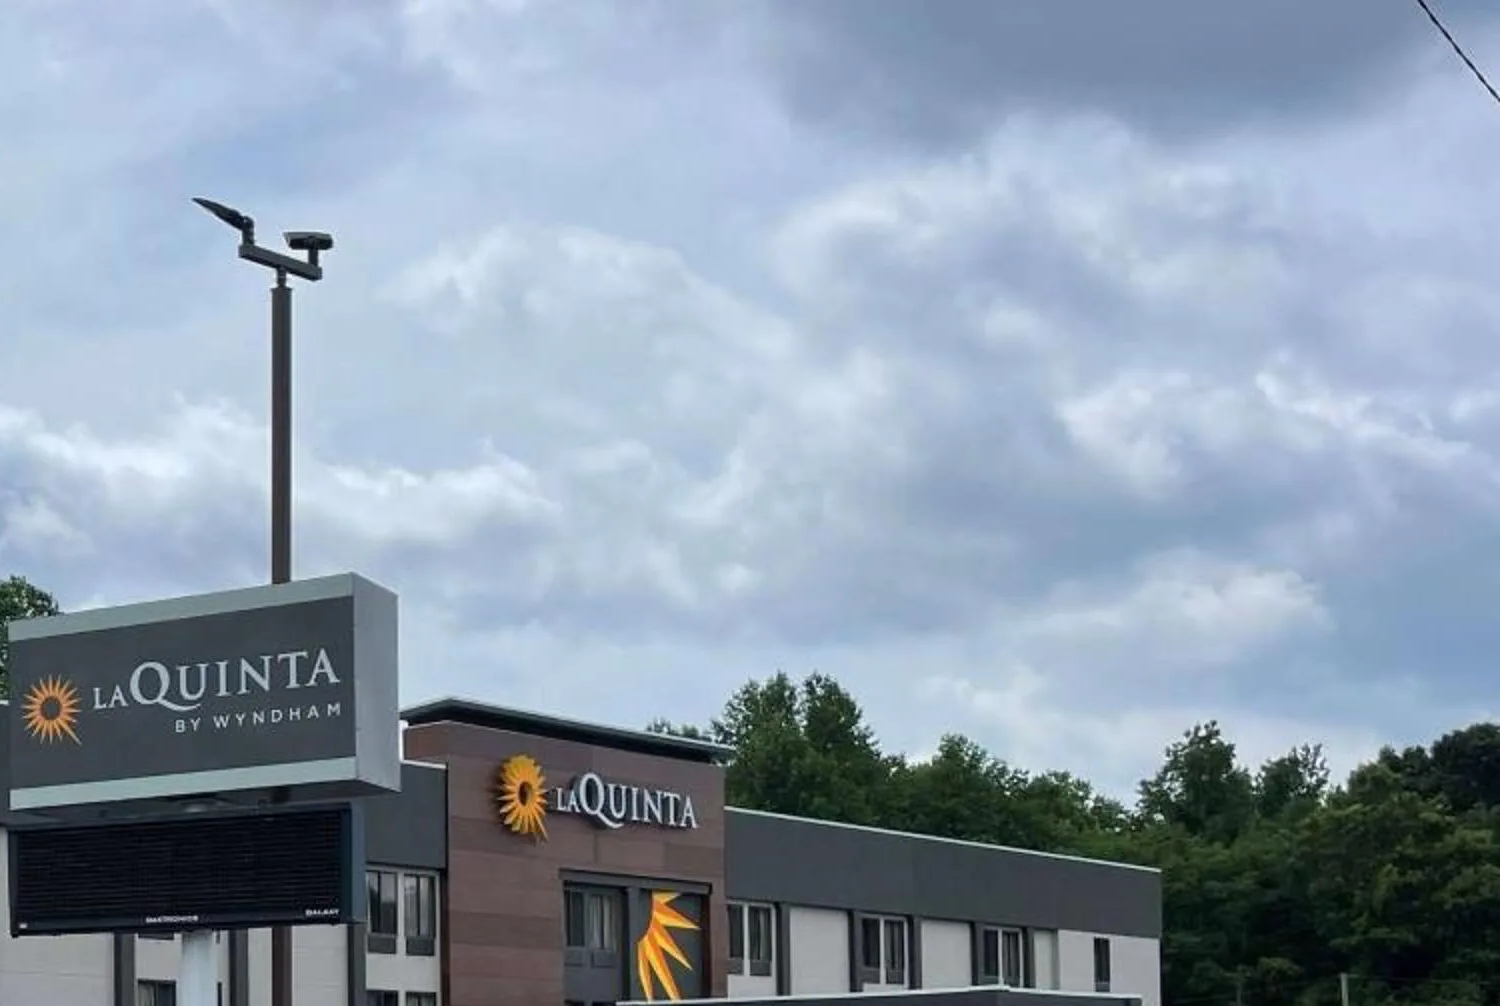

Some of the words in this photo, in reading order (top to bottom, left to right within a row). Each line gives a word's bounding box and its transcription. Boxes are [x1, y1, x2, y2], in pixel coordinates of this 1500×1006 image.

[92, 685, 129, 710] LA
[129, 648, 341, 712] QUINTA
[175, 717, 202, 733] BY
[213, 702, 341, 730] WYNDHAM
[556, 787, 580, 813] LA
[579, 772, 699, 829] QUINTA
